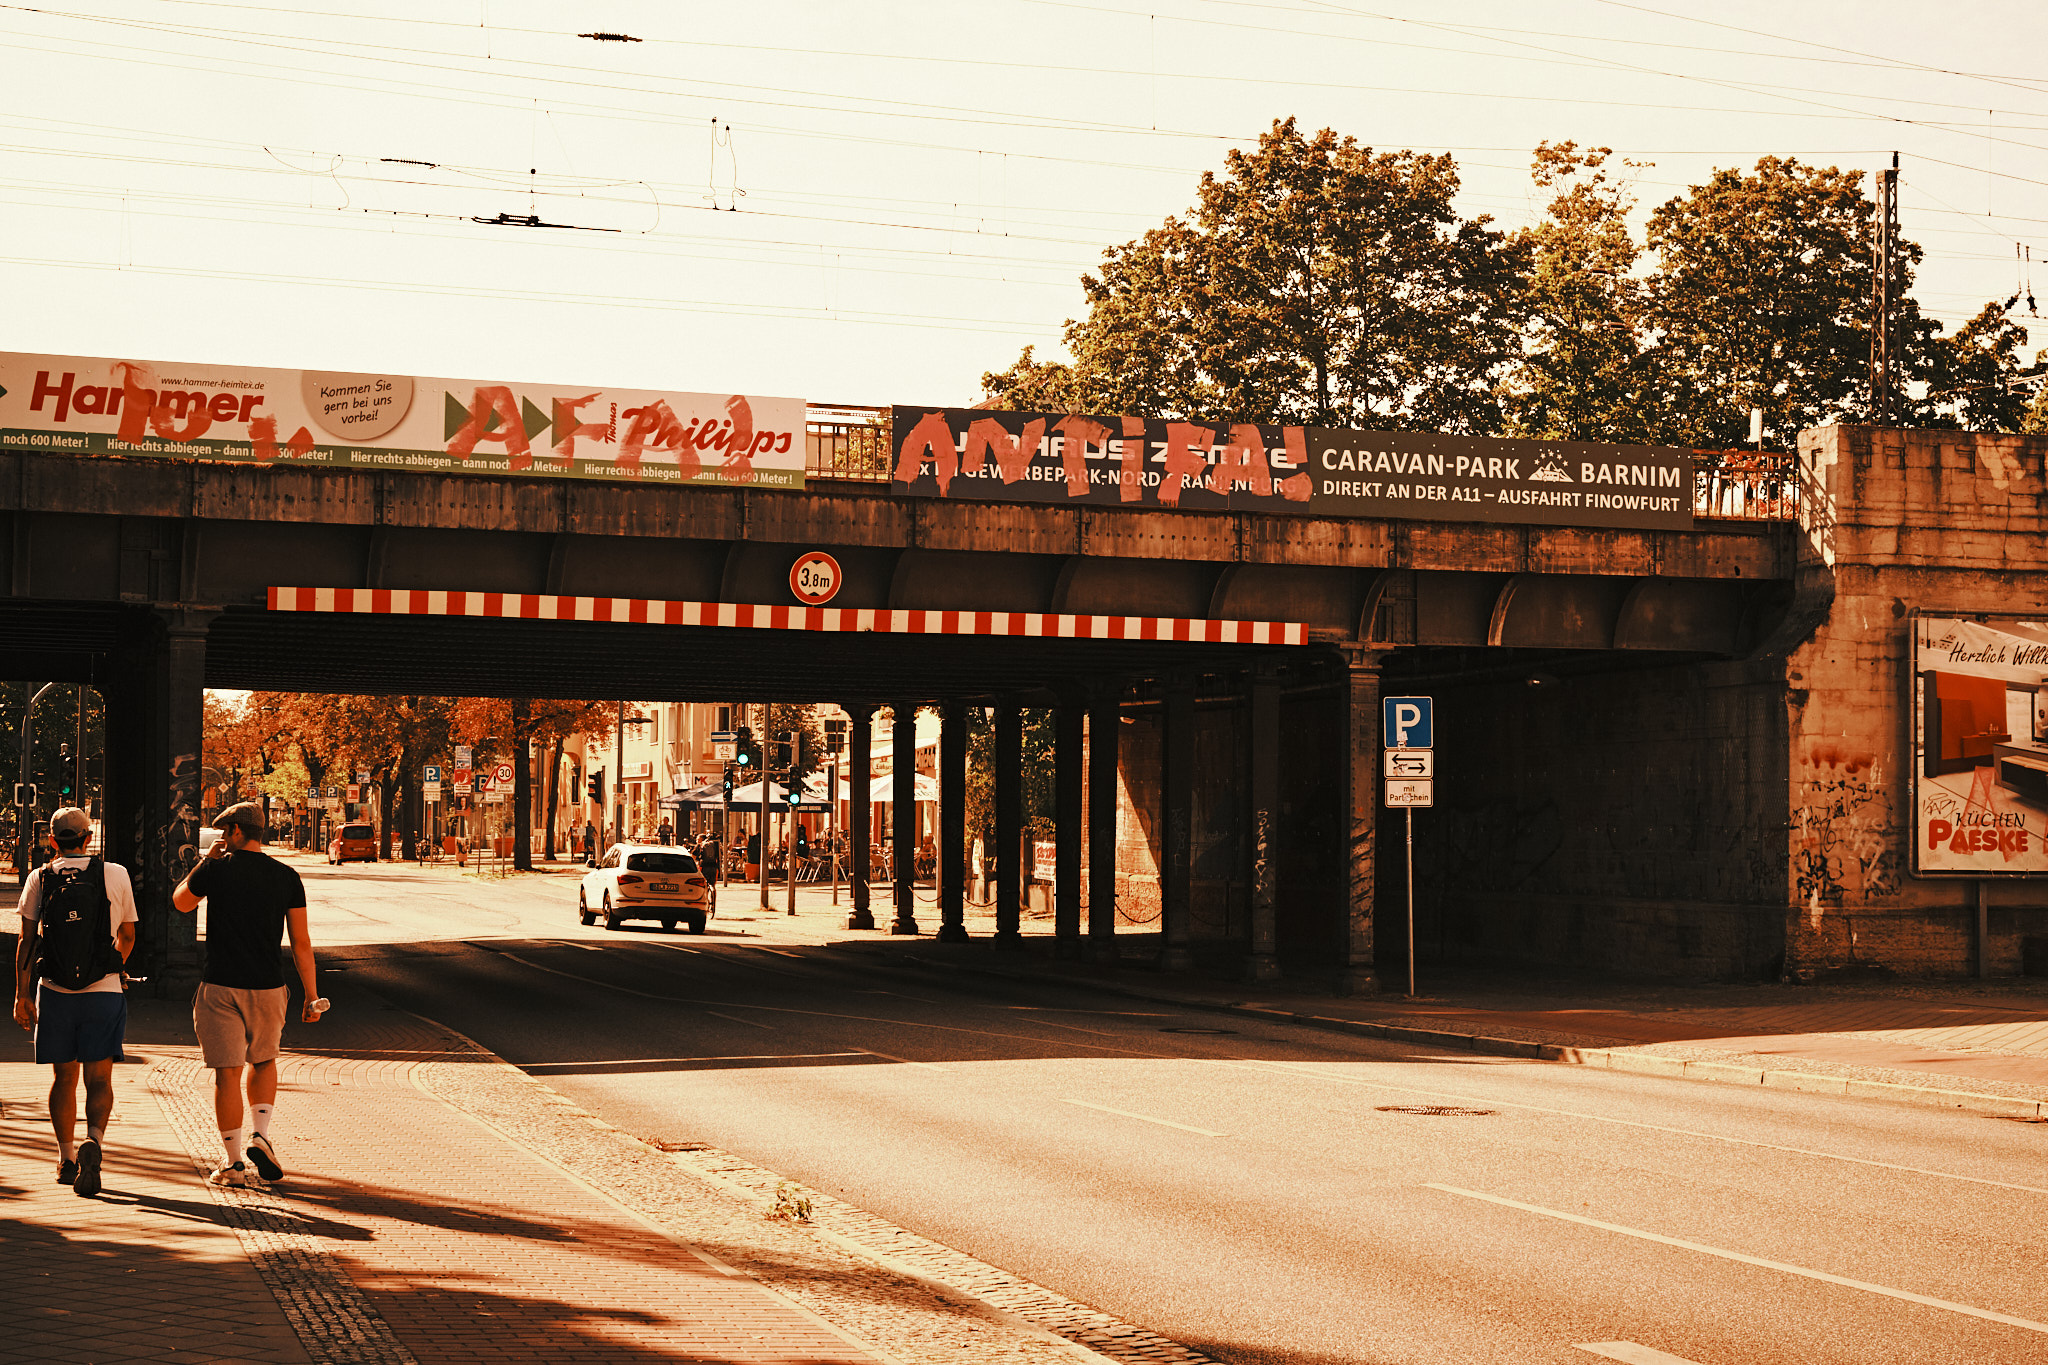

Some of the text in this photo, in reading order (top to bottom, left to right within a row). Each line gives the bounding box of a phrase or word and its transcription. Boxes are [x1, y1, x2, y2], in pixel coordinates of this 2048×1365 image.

[161, 377, 264, 390] www.hammer-heimtex.de
[320, 379, 392, 398] Kommen Sie
[324, 396, 392, 415] gern bei uns
[341, 409, 378, 424] vorbei!
[604, 402, 617, 444] Thomas
[3, 434, 28, 445] noch
[30, 435, 50, 446] 600
[621, 405, 793, 458] Philipps
[107, 438, 131, 450] Hier
[164, 442, 212, 455] abbiegen
[224, 445, 249, 456] dann
[351, 451, 371, 463] Hier
[374, 453, 404, 465] rechts
[405, 454, 451, 468] abbiegen
[463, 457, 487, 469] dann
[1322, 448, 1681, 488] CARAVAN-PARK BARNIM
[585, 464, 604, 475] Hier
[606, 465, 635, 477] rechts
[637, 467, 681, 480] abbiegen
[1323, 480, 1382, 497] DIREKT
[1386, 483, 1410, 499] AN
[1415, 485, 1447, 501] DER
[1451, 487, 1481, 502] A11
[1497, 488, 1581, 507] AUSFAHRT
[1585, 493, 1681, 512] FINOWFURT
[1949, 641, 2006, 663] Herzlich
[1396, 703, 1421, 741] P
[426, 767, 436, 781] P
[499, 768, 511, 778] 30
[1956, 810, 2025, 827] KÜCHEN
[1929, 819, 2028, 852] PAESKE
